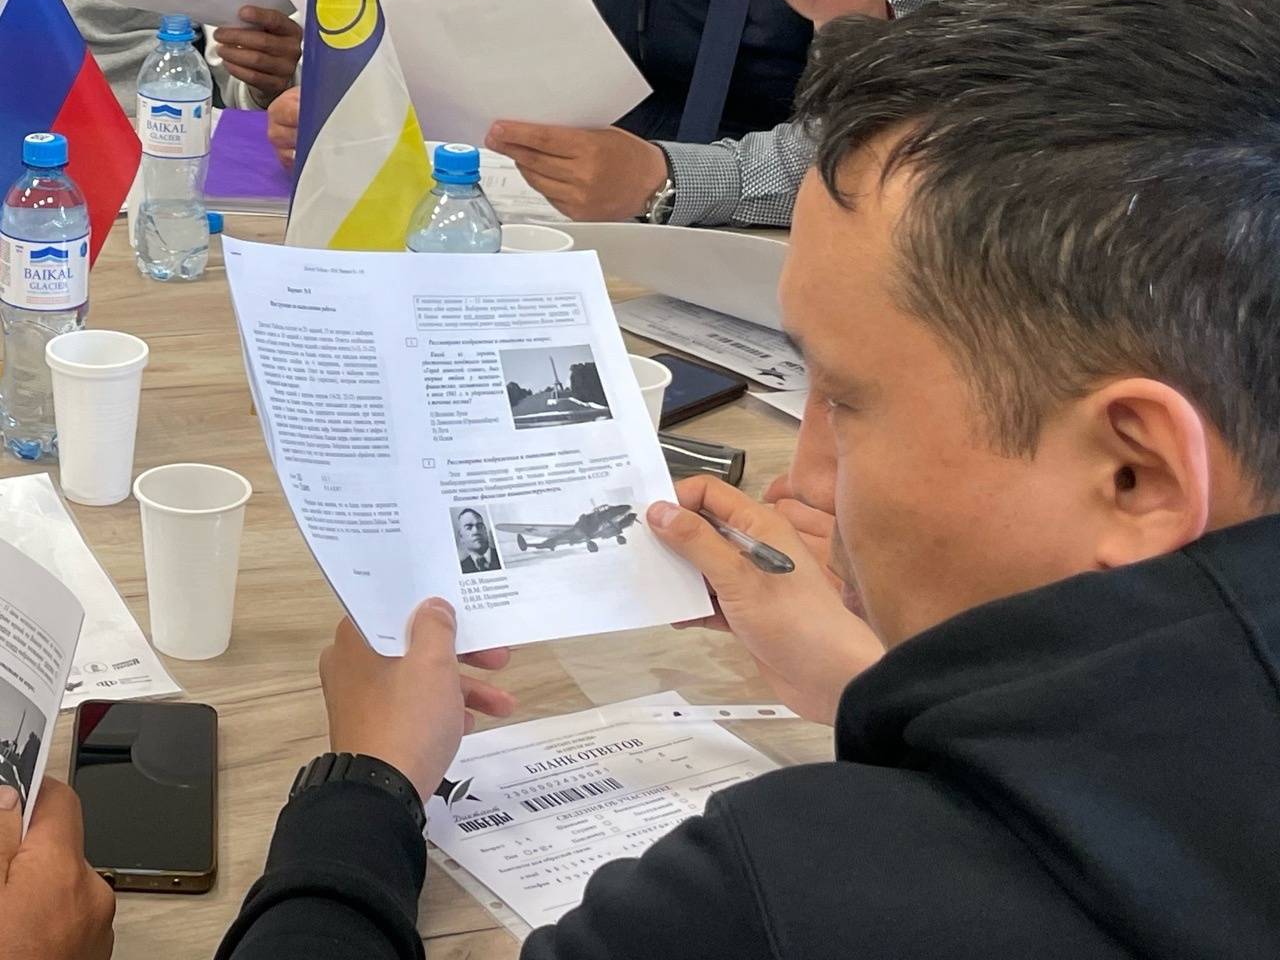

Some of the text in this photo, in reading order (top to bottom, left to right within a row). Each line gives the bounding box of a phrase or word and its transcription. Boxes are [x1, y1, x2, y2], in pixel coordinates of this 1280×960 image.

[146, 120, 187, 134] BAIKAL
[24, 268, 74, 281] BAIKAL
[524, 753, 578, 775] БЛАНК
[577, 738, 644, 761] ОТВЕТОВ
[457, 811, 515, 833] ПОБЕДЫ
